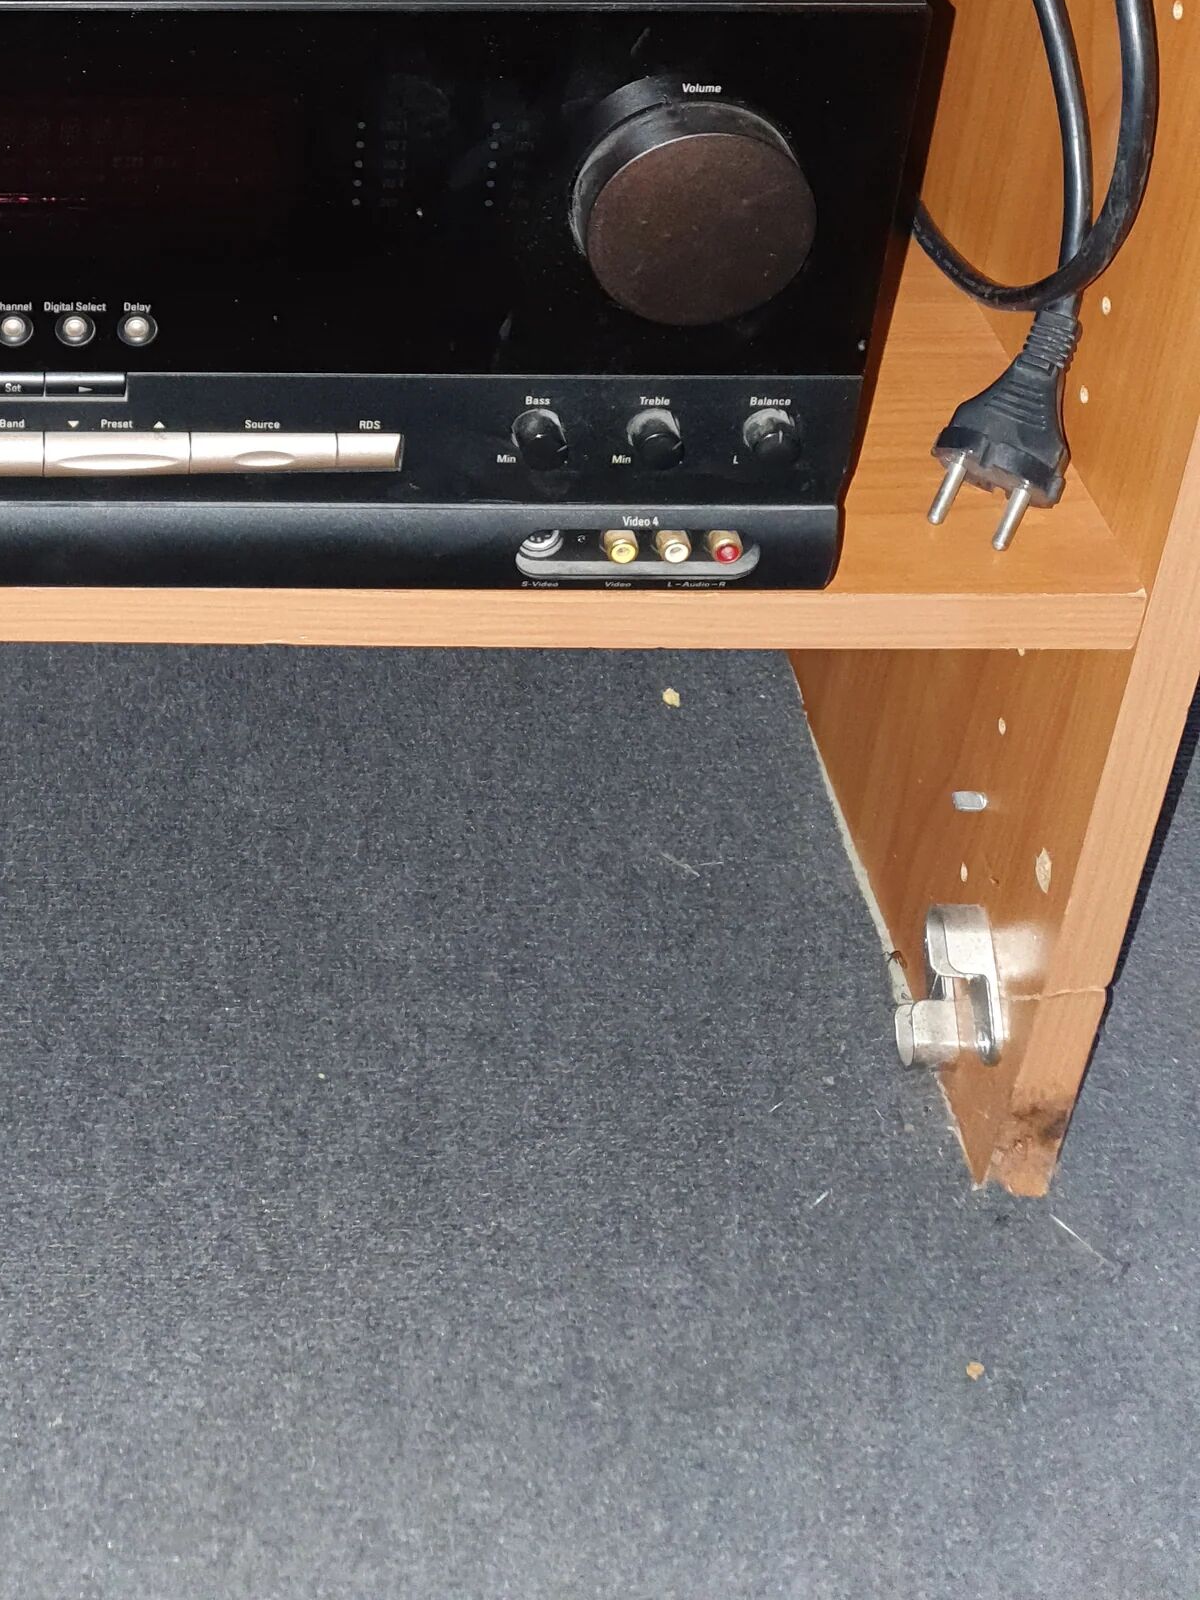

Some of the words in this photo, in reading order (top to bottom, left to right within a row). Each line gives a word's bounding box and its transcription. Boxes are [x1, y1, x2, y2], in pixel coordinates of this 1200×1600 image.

[682, 83, 722, 93] Volume
[43, 302, 75, 314] Digital
[76, 302, 106, 312] Select
[123, 302, 151, 315] Delay
[5, 383, 21, 393] Set
[525, 396, 550, 405] Bass
[639, 396, 670, 406] Treble
[749, 397, 791, 407] Balance
[0, 419, 26, 429] Band
[100, 419, 133, 429] Preset
[244, 419, 281, 429] Source
[359, 420, 381, 430] RDS
[496, 454, 517, 464] Min
[611, 454, 632, 464] Min
[622, 516, 650, 527] Video
[652, 517, 659, 526] 4
